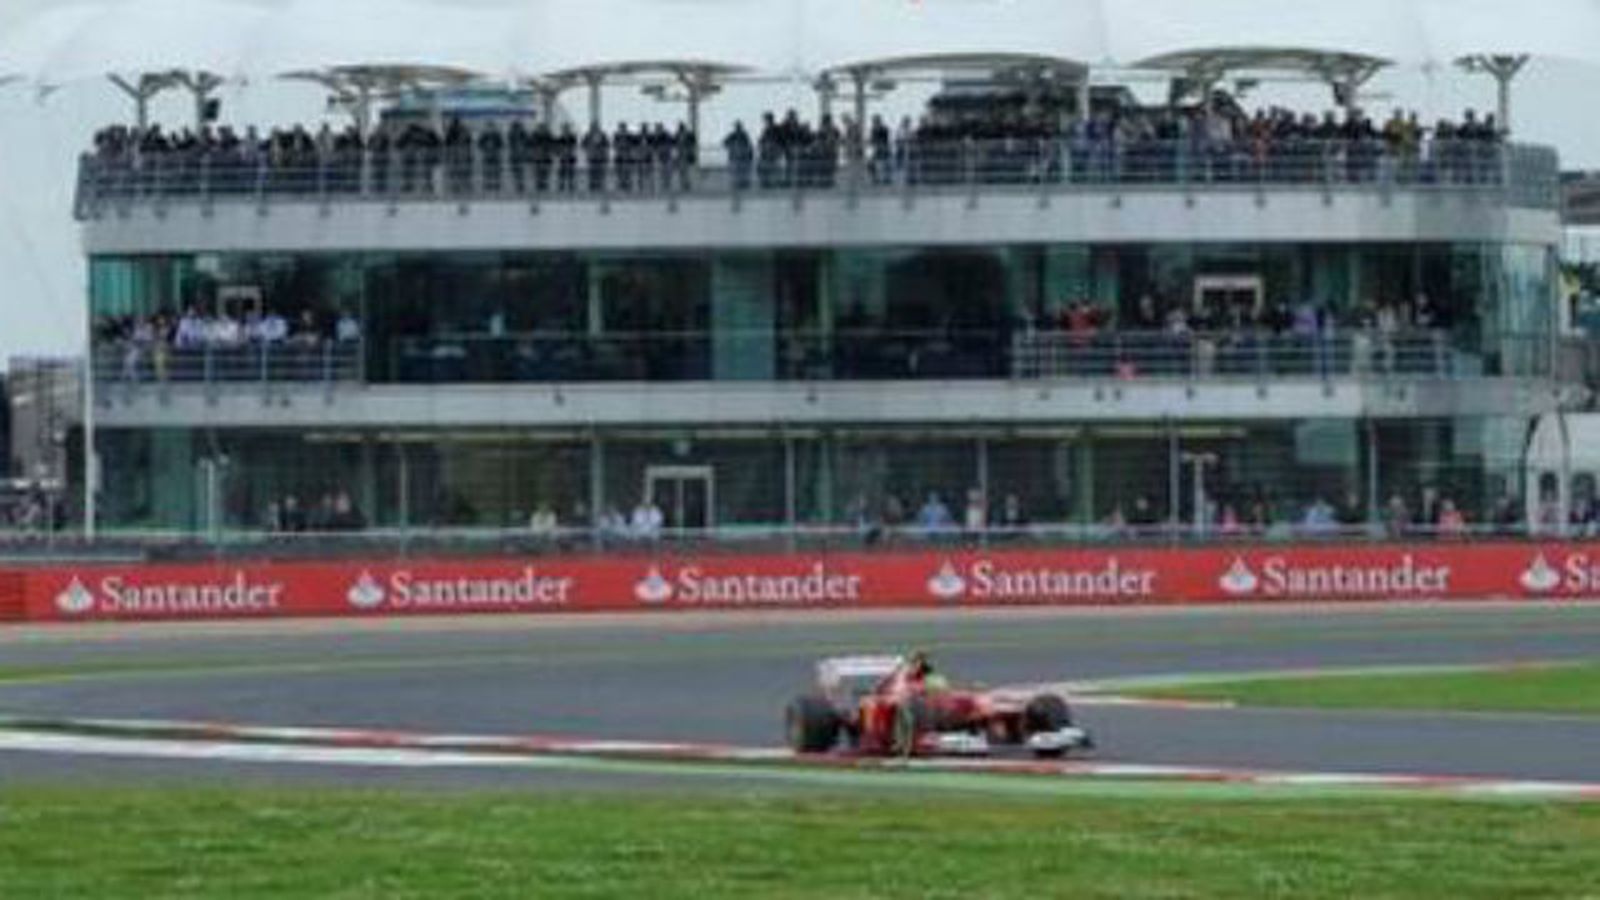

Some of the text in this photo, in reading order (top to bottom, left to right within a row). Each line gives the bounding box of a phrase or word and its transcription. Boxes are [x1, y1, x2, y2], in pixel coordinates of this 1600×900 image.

[101, 572, 281, 611] Santander
[390, 567, 573, 607] Santander
[677, 562, 860, 602] Santander
[971, 558, 1154, 597] Santander
[1263, 555, 1450, 594] Santander
